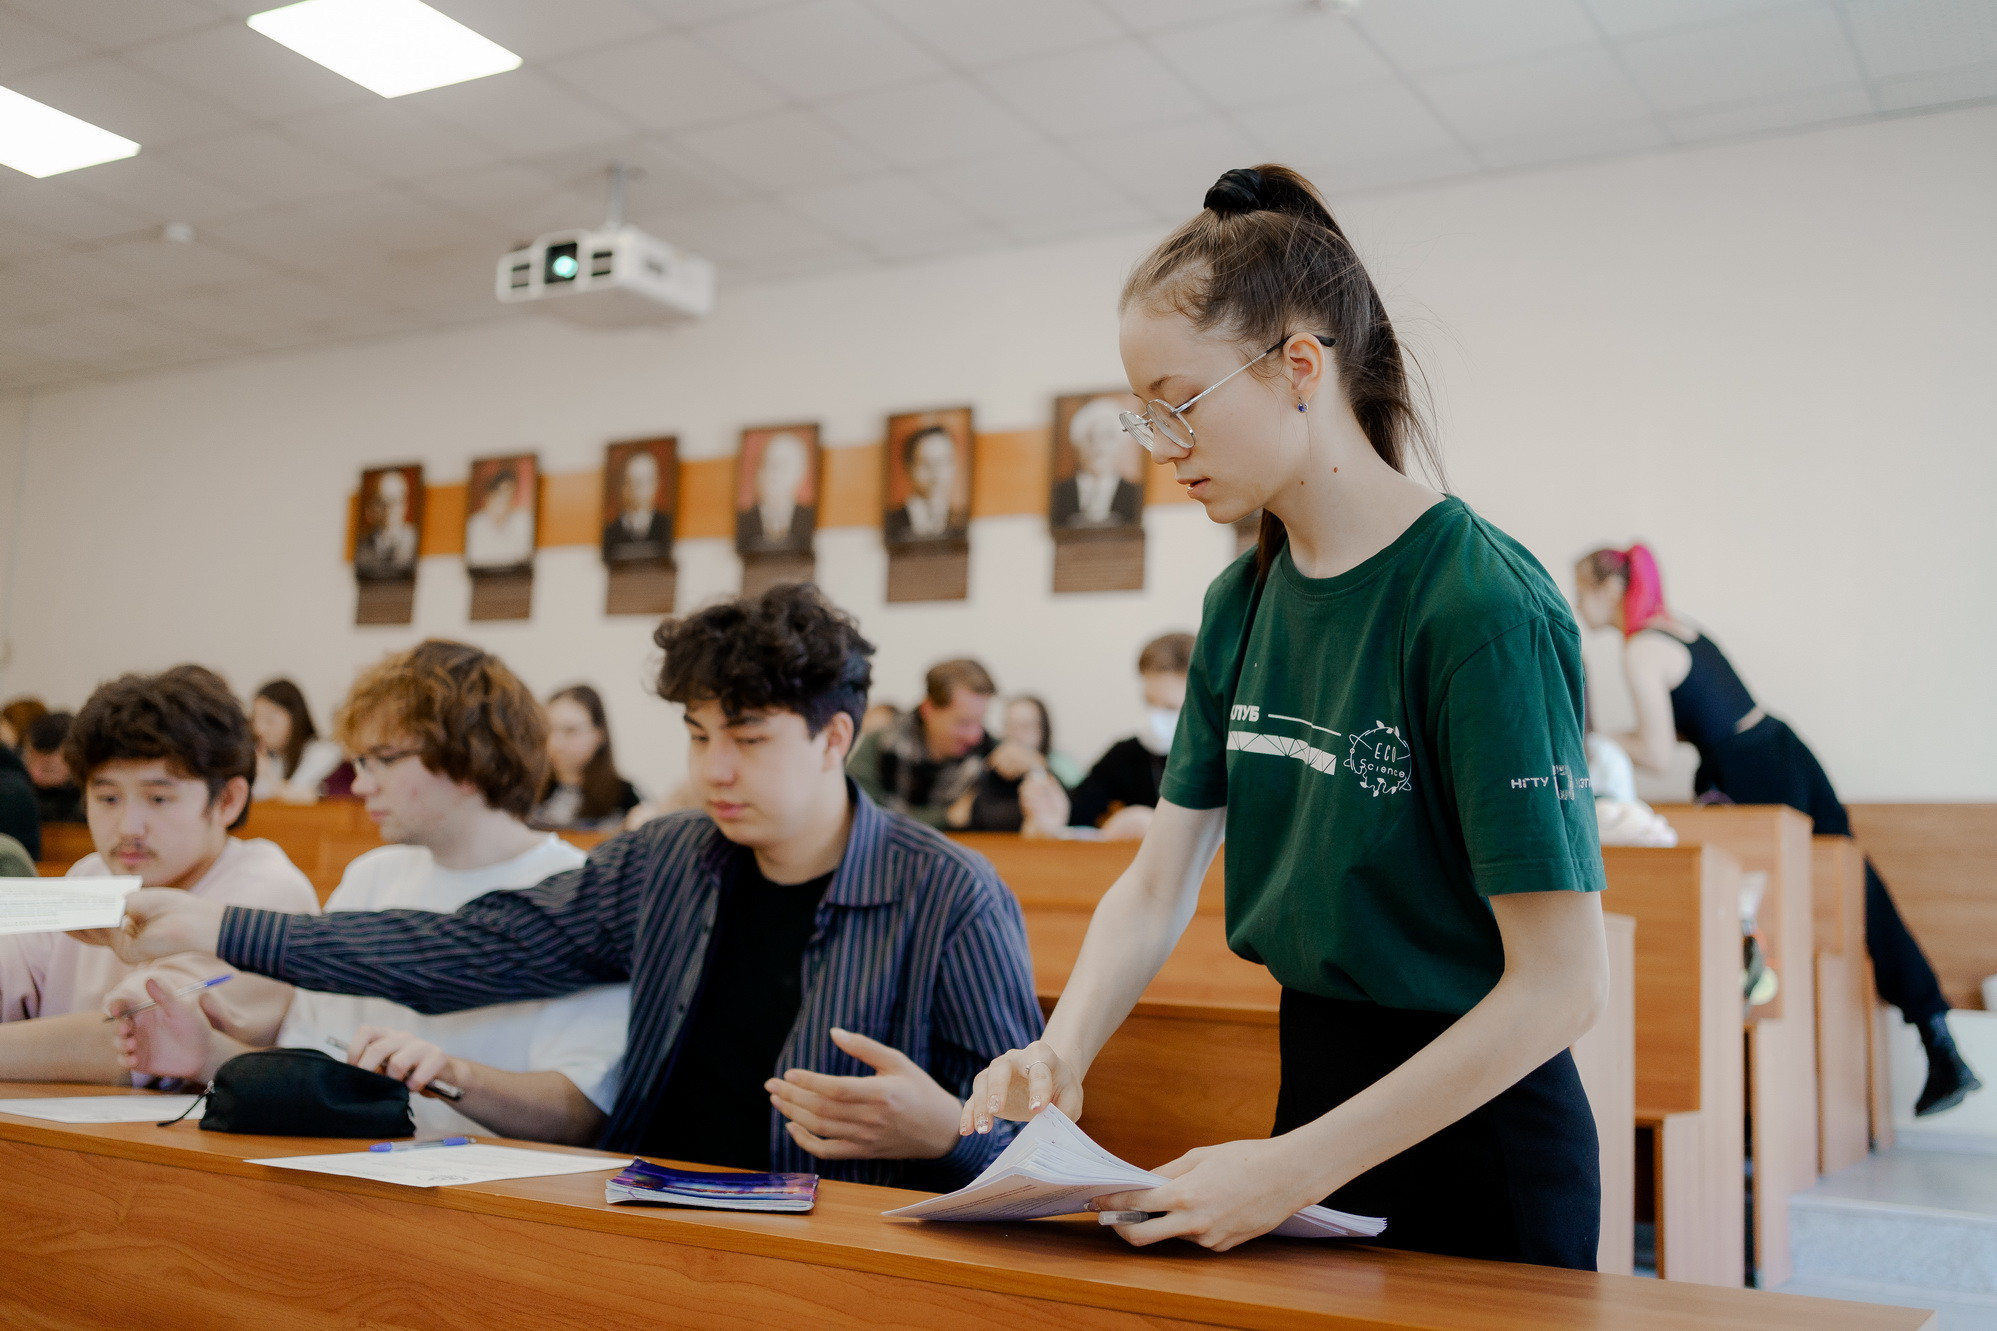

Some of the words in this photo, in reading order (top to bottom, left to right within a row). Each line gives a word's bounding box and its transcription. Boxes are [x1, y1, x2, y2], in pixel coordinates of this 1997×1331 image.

[1374, 742, 1397, 763] ECO
[1360, 758, 1406, 778] Science
[1510, 776, 1549, 789] НГТУ
